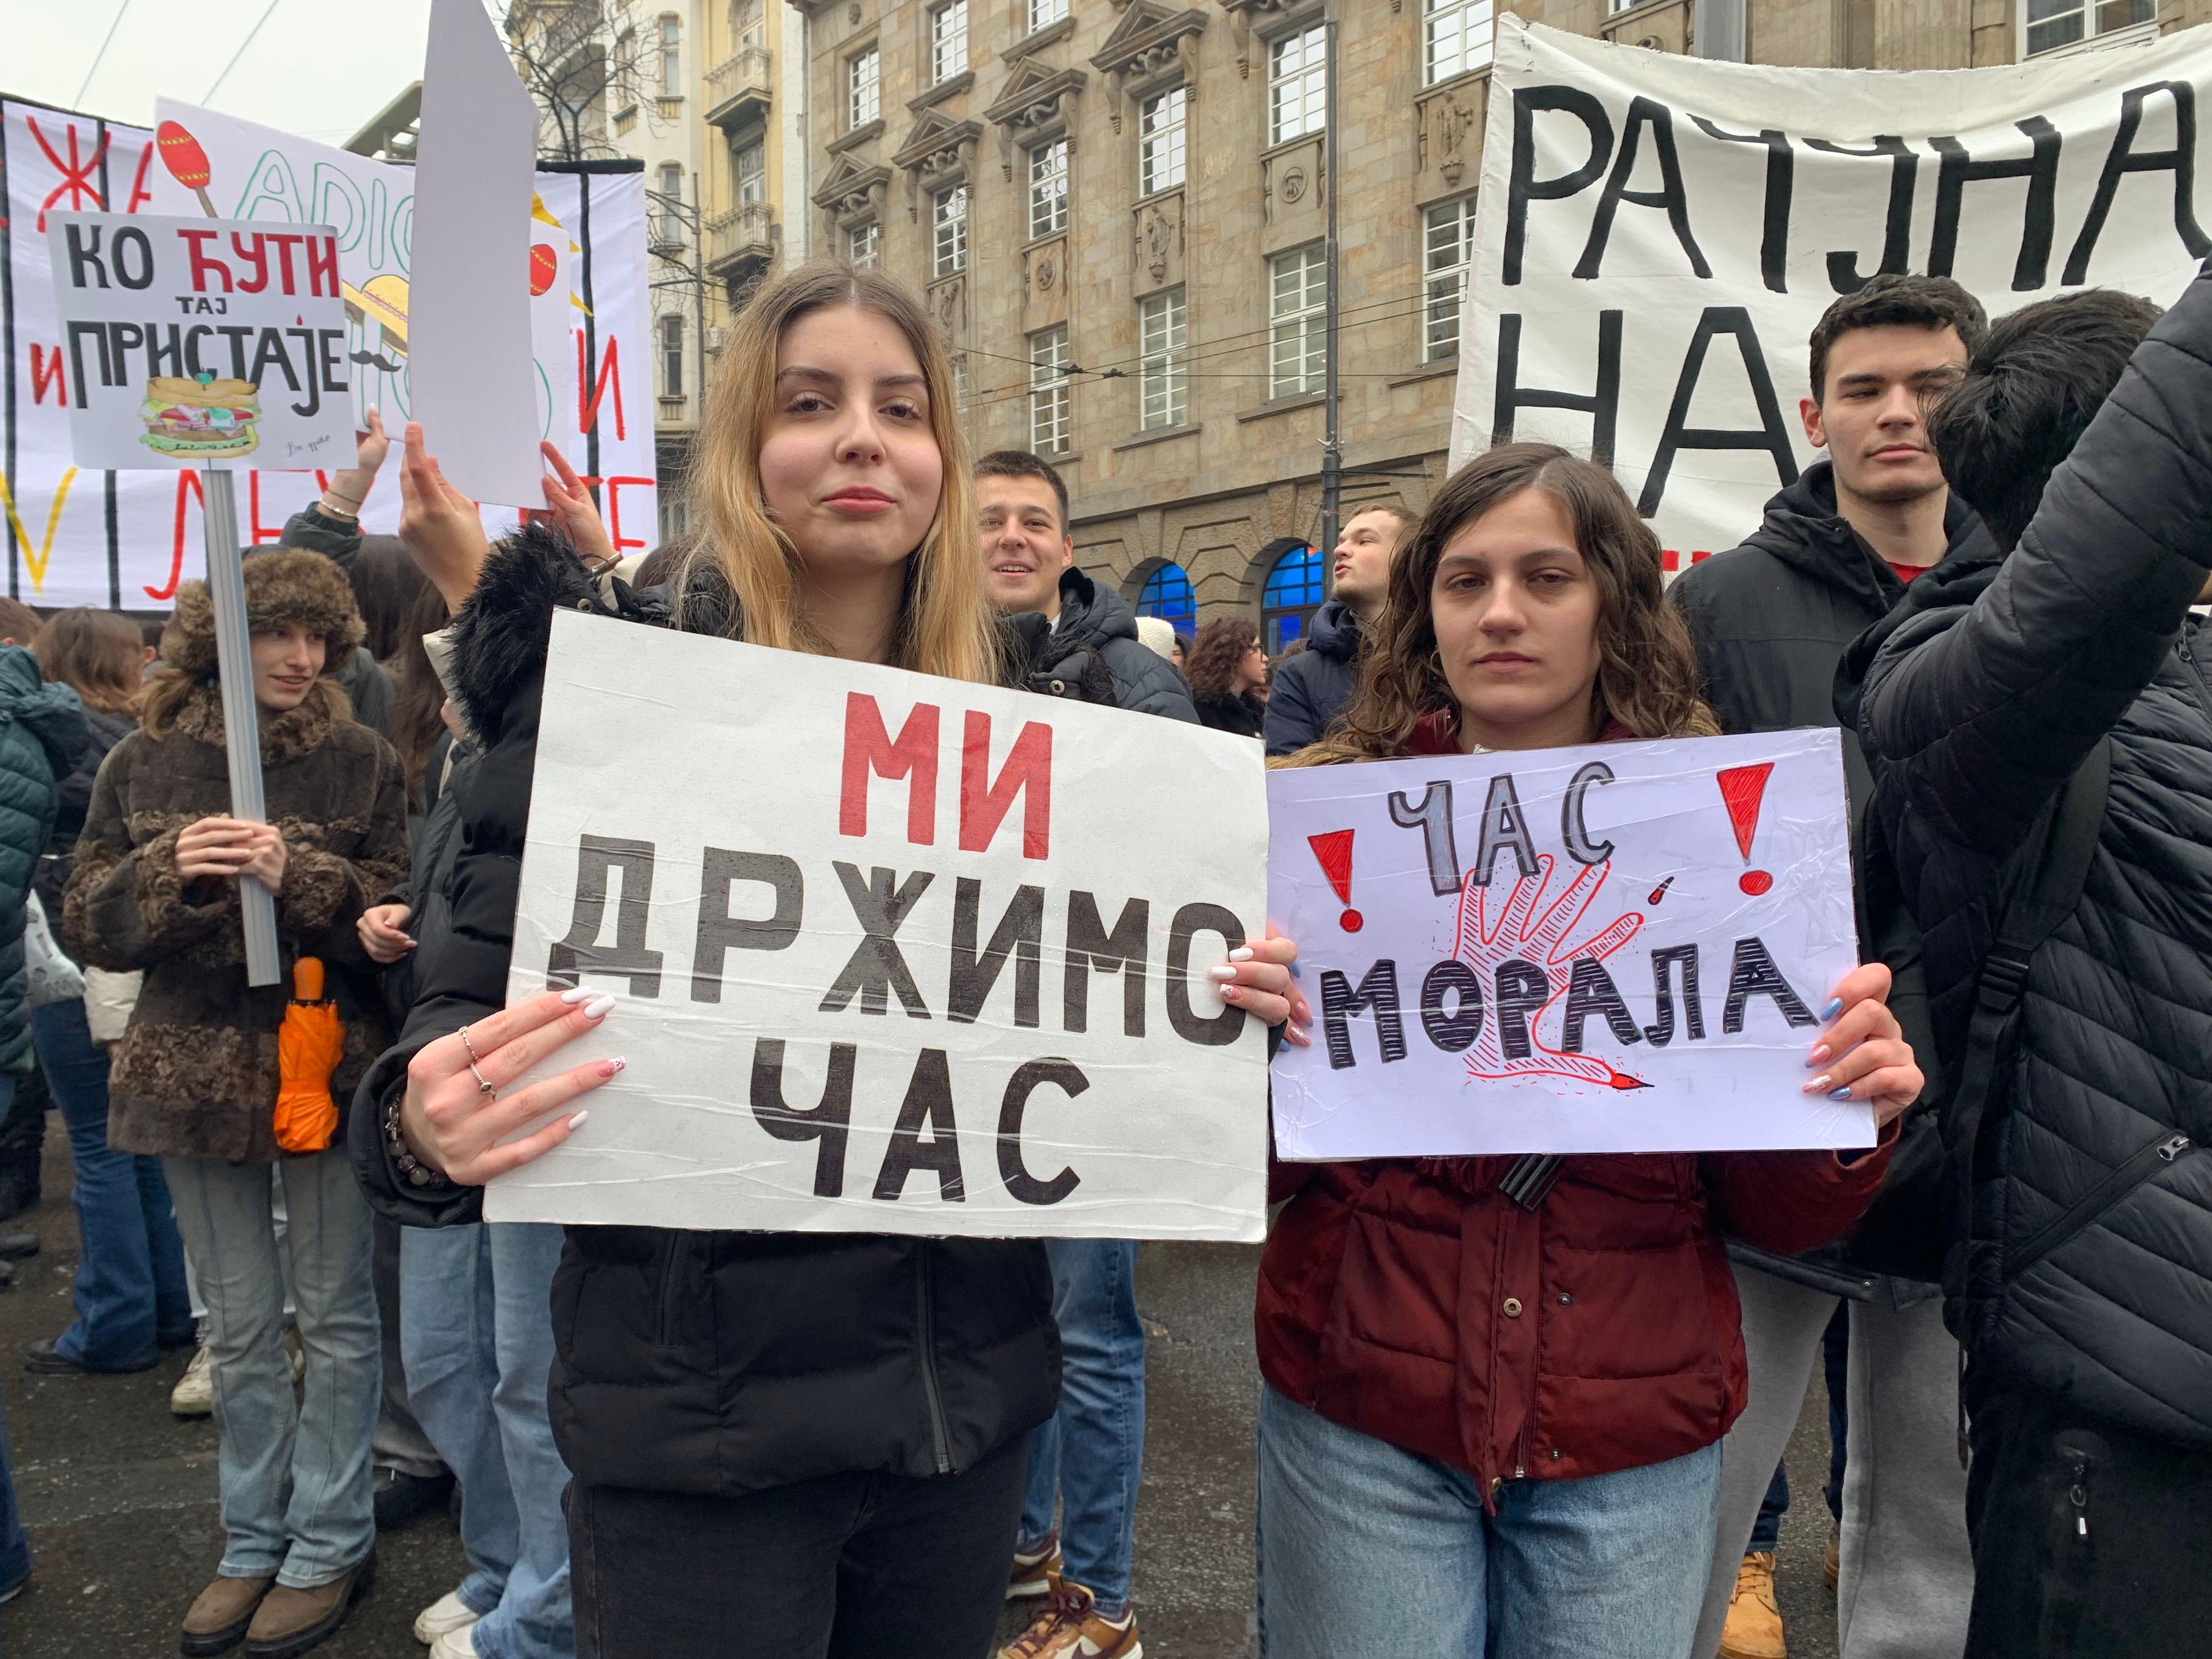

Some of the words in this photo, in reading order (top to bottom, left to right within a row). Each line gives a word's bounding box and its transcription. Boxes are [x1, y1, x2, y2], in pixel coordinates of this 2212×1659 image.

[65, 223, 155, 290] КО
[177, 228, 340, 298] ЋУТИ
[175, 296, 227, 315] ТАЈ
[66, 320, 349, 417] ПРИСТАЈЕ
[839, 691, 1053, 860] МИ
[1387, 761, 1616, 896] ЧАС
[546, 833, 1247, 1047] ДРЖИМО
[1319, 936, 1819, 1069] МОРАЛА
[749, 1036, 1091, 1205] ЧАС
